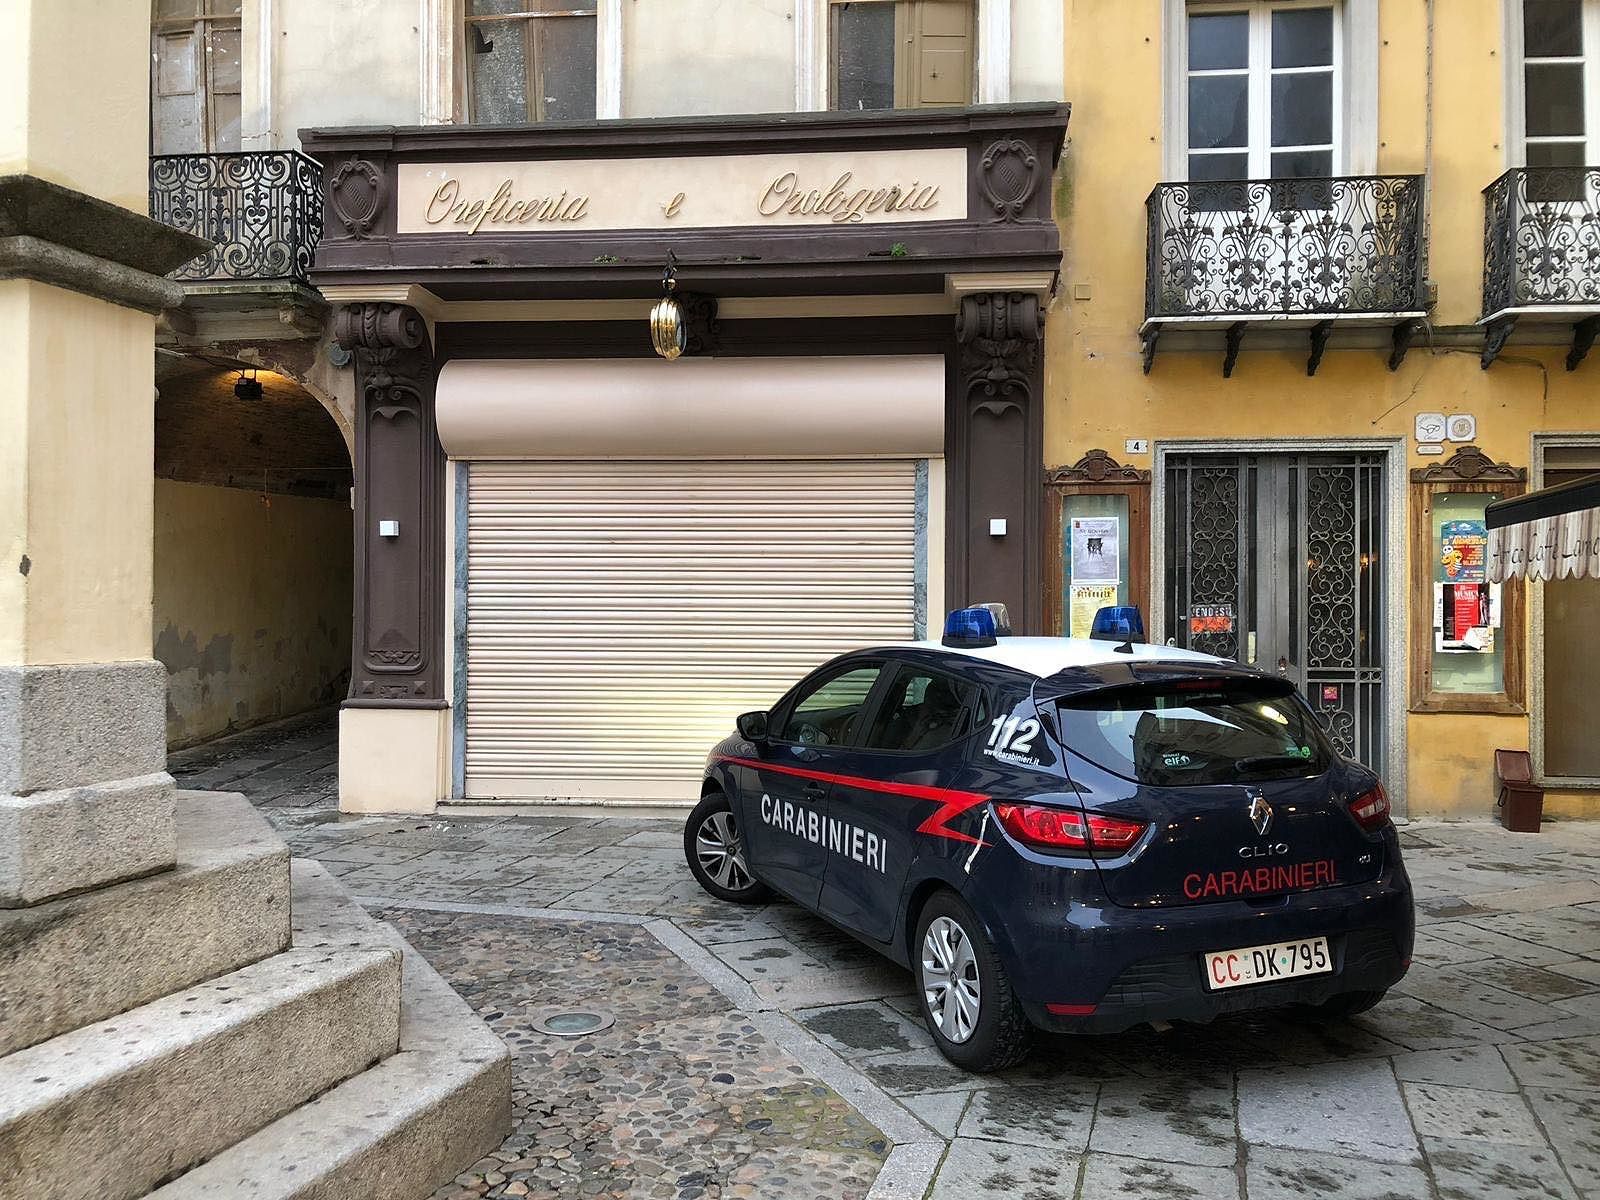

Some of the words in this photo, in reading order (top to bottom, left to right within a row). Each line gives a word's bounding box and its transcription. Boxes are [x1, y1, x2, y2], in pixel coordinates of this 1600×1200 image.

[425, 178, 590, 235] Oreficeria
[662, 192, 686, 217] e
[758, 171, 940, 222] Orologeria
[1133, 441, 1140, 451] 4
[988, 714, 1040, 753] 112
[983, 749, 1040, 766] www.carabinieri.it
[761, 793, 887, 874] CARABINIERI
[1183, 860, 1336, 899] CARABINIERI
[1212, 954, 1240, 984] CC
[1252, 949, 1281, 978] DK
[1286, 941, 1326, 973] 795
